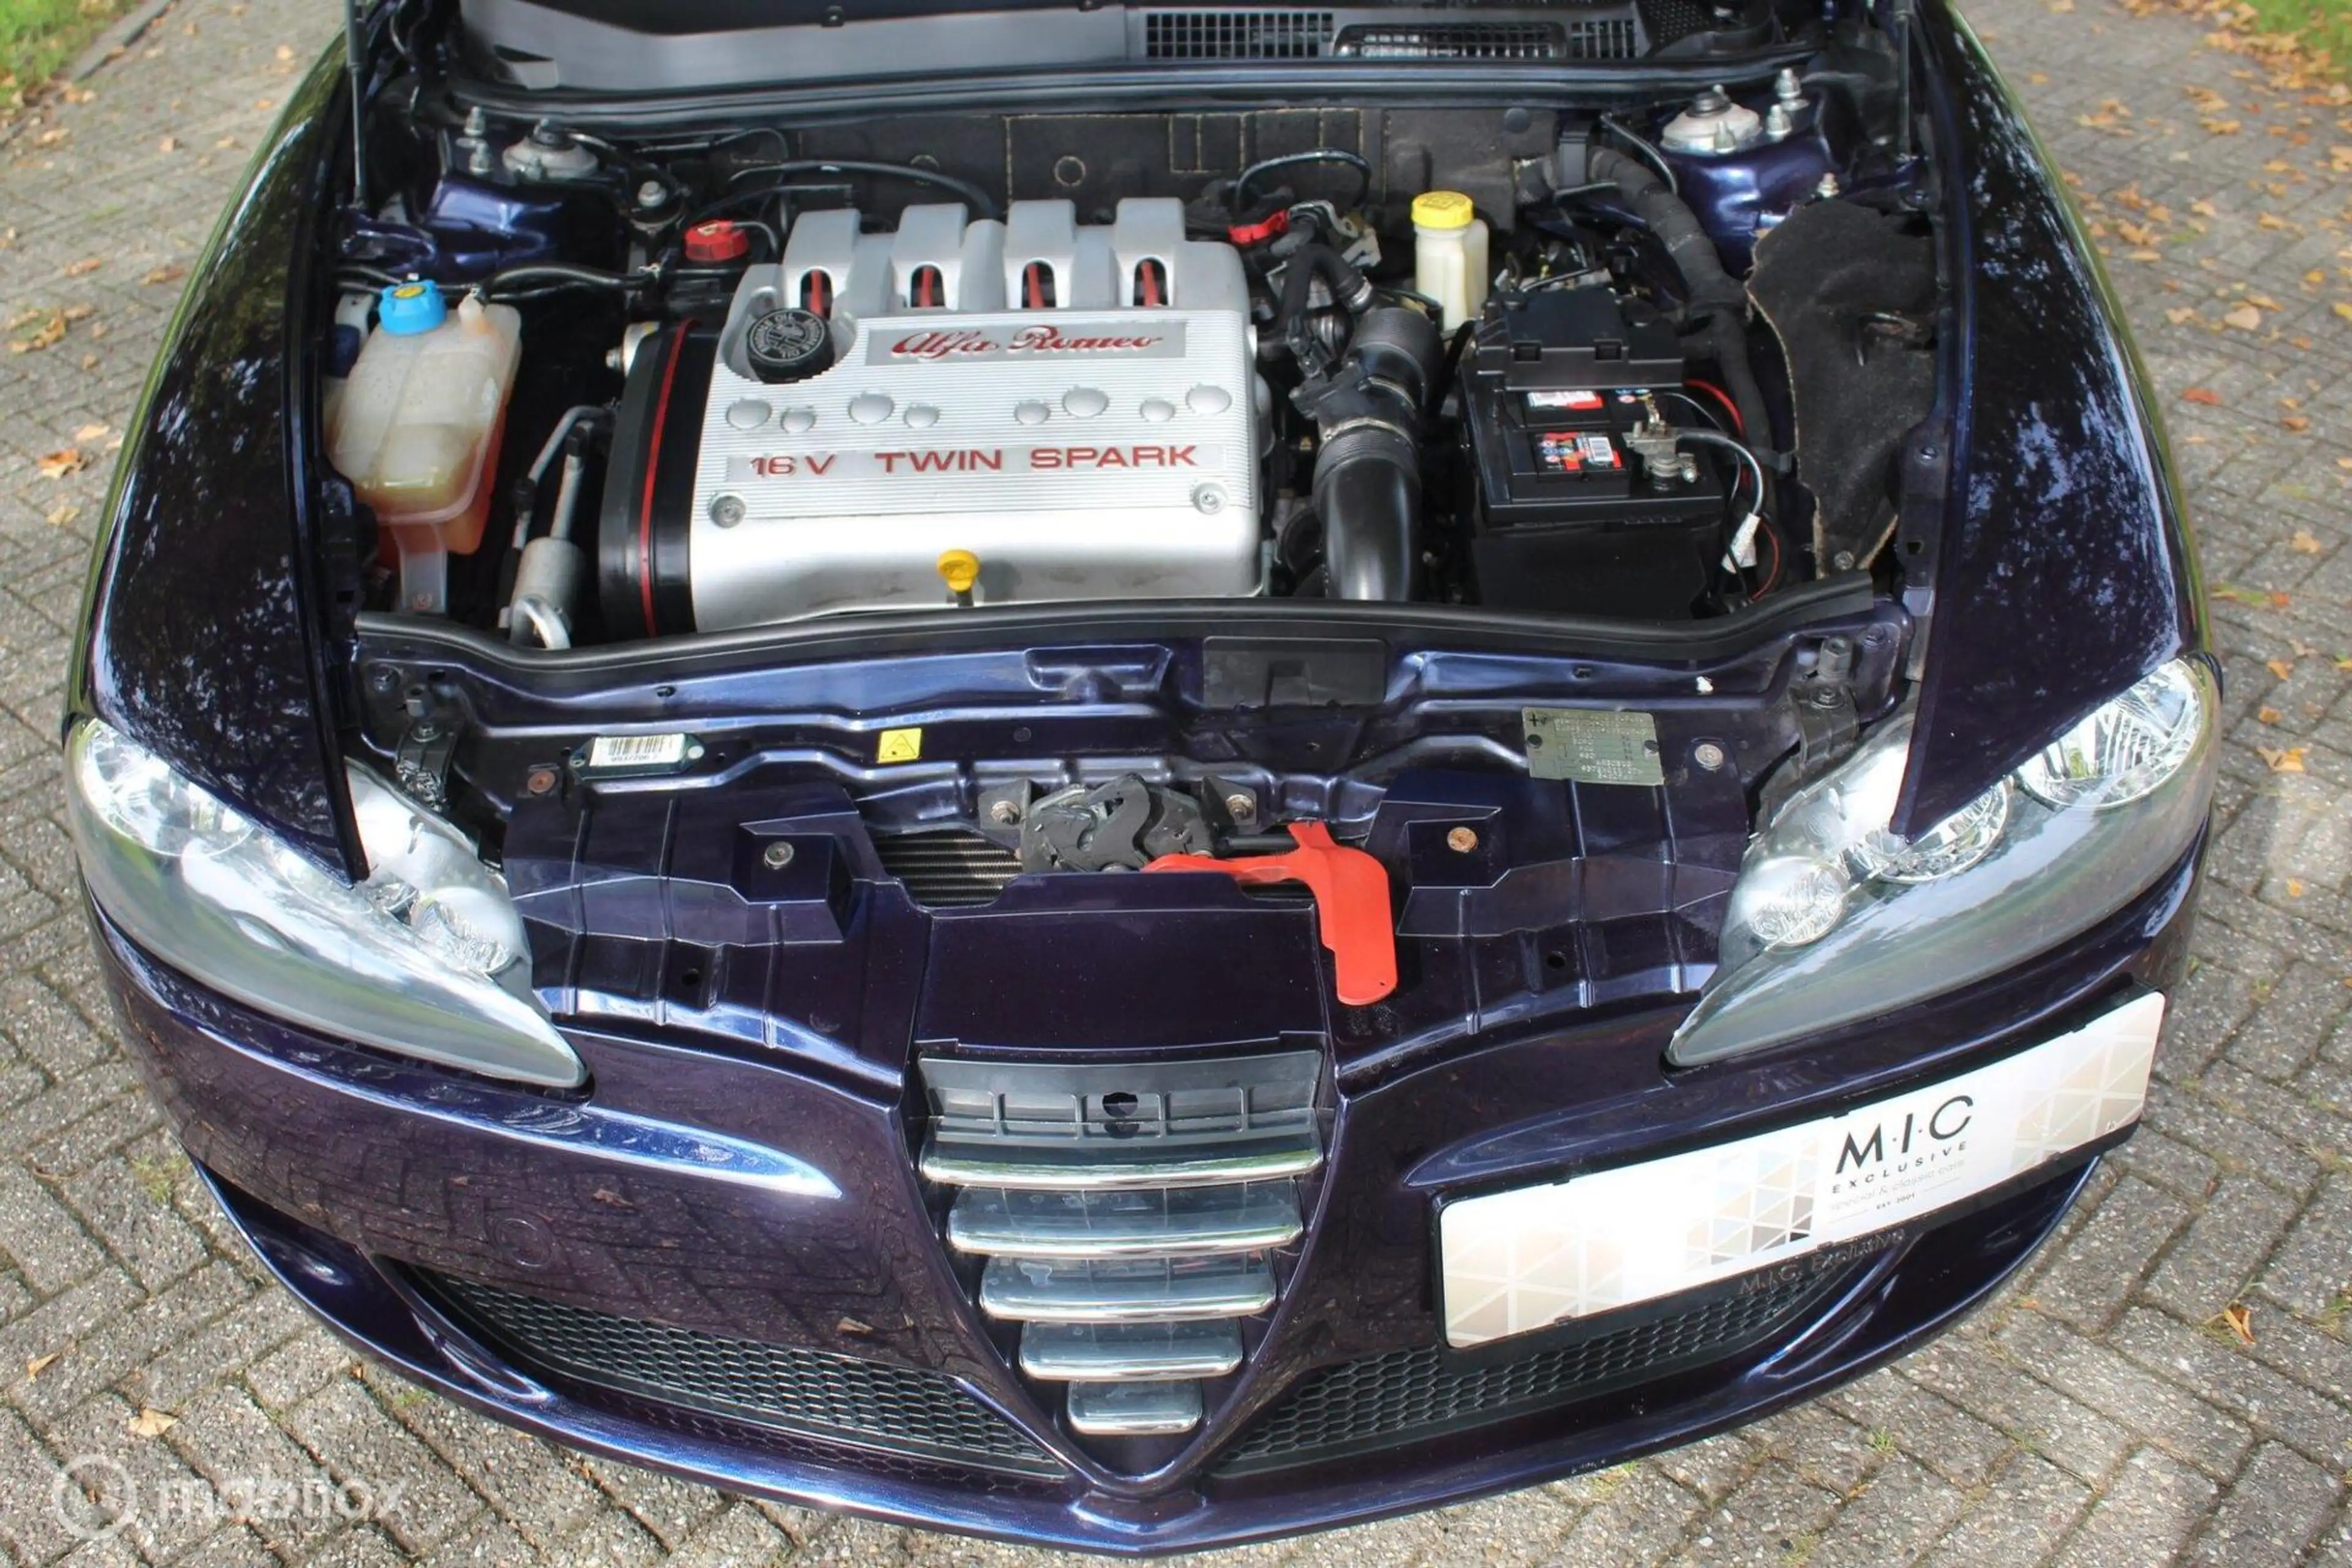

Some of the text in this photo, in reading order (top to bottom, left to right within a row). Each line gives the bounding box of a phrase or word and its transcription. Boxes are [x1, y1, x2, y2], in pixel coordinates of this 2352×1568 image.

[891, 324, 1163, 360] Alfa Romeo
[874, 449, 1003, 473] TWIN
[1030, 445, 1198, 469] SPARK
[1832, 1140, 1967, 1194] EXCLUSIVE
